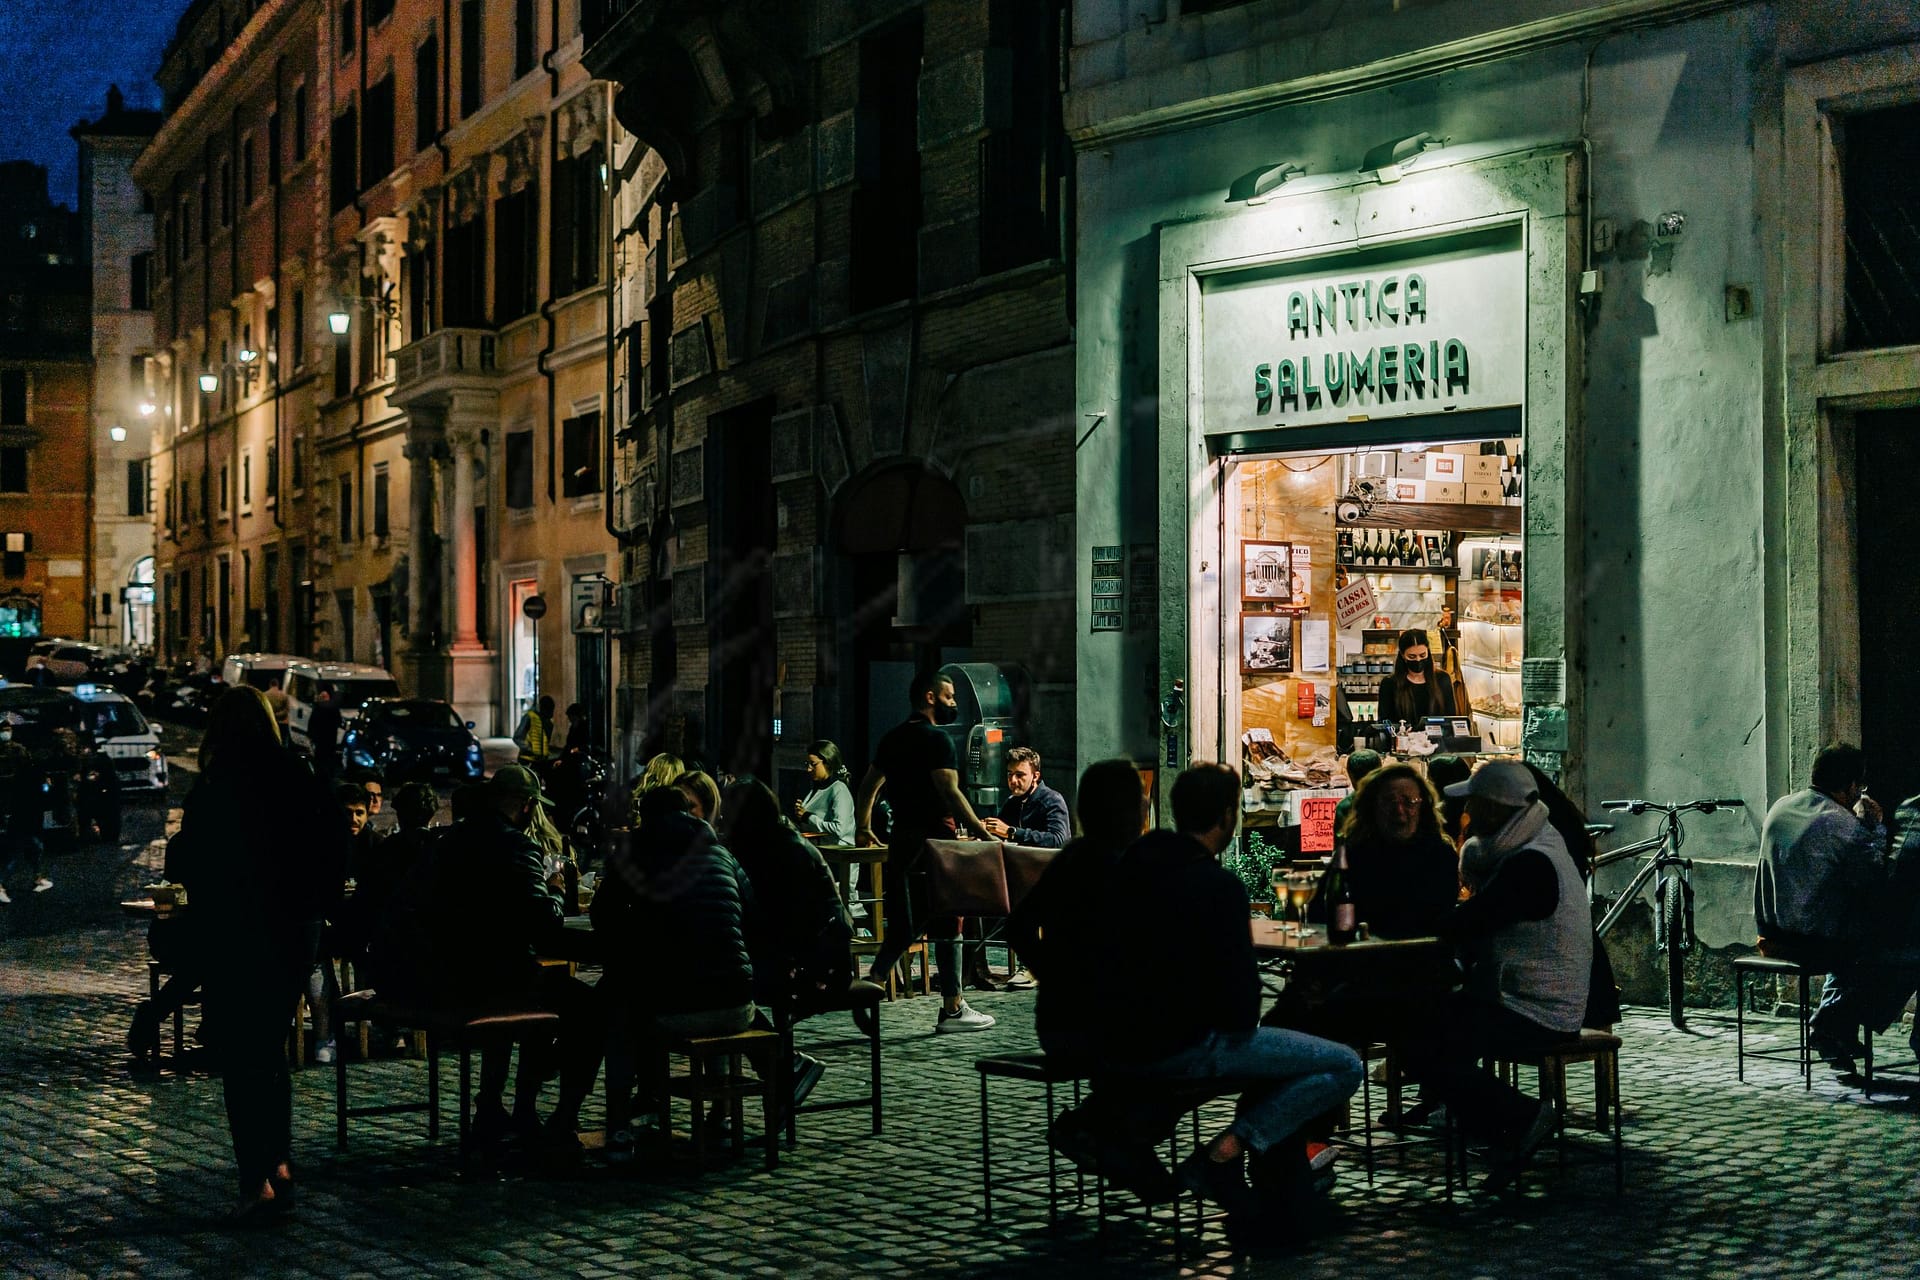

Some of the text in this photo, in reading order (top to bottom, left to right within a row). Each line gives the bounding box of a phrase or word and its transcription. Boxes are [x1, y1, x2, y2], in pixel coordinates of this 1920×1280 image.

[1595, 223, 1609, 247] 4
[1287, 273, 1427, 332] ANTICA
[1255, 338, 1468, 402] SALUMERIA
[1337, 587, 1367, 609] CASSA
[1341, 599, 1370, 619] CASH DESK
